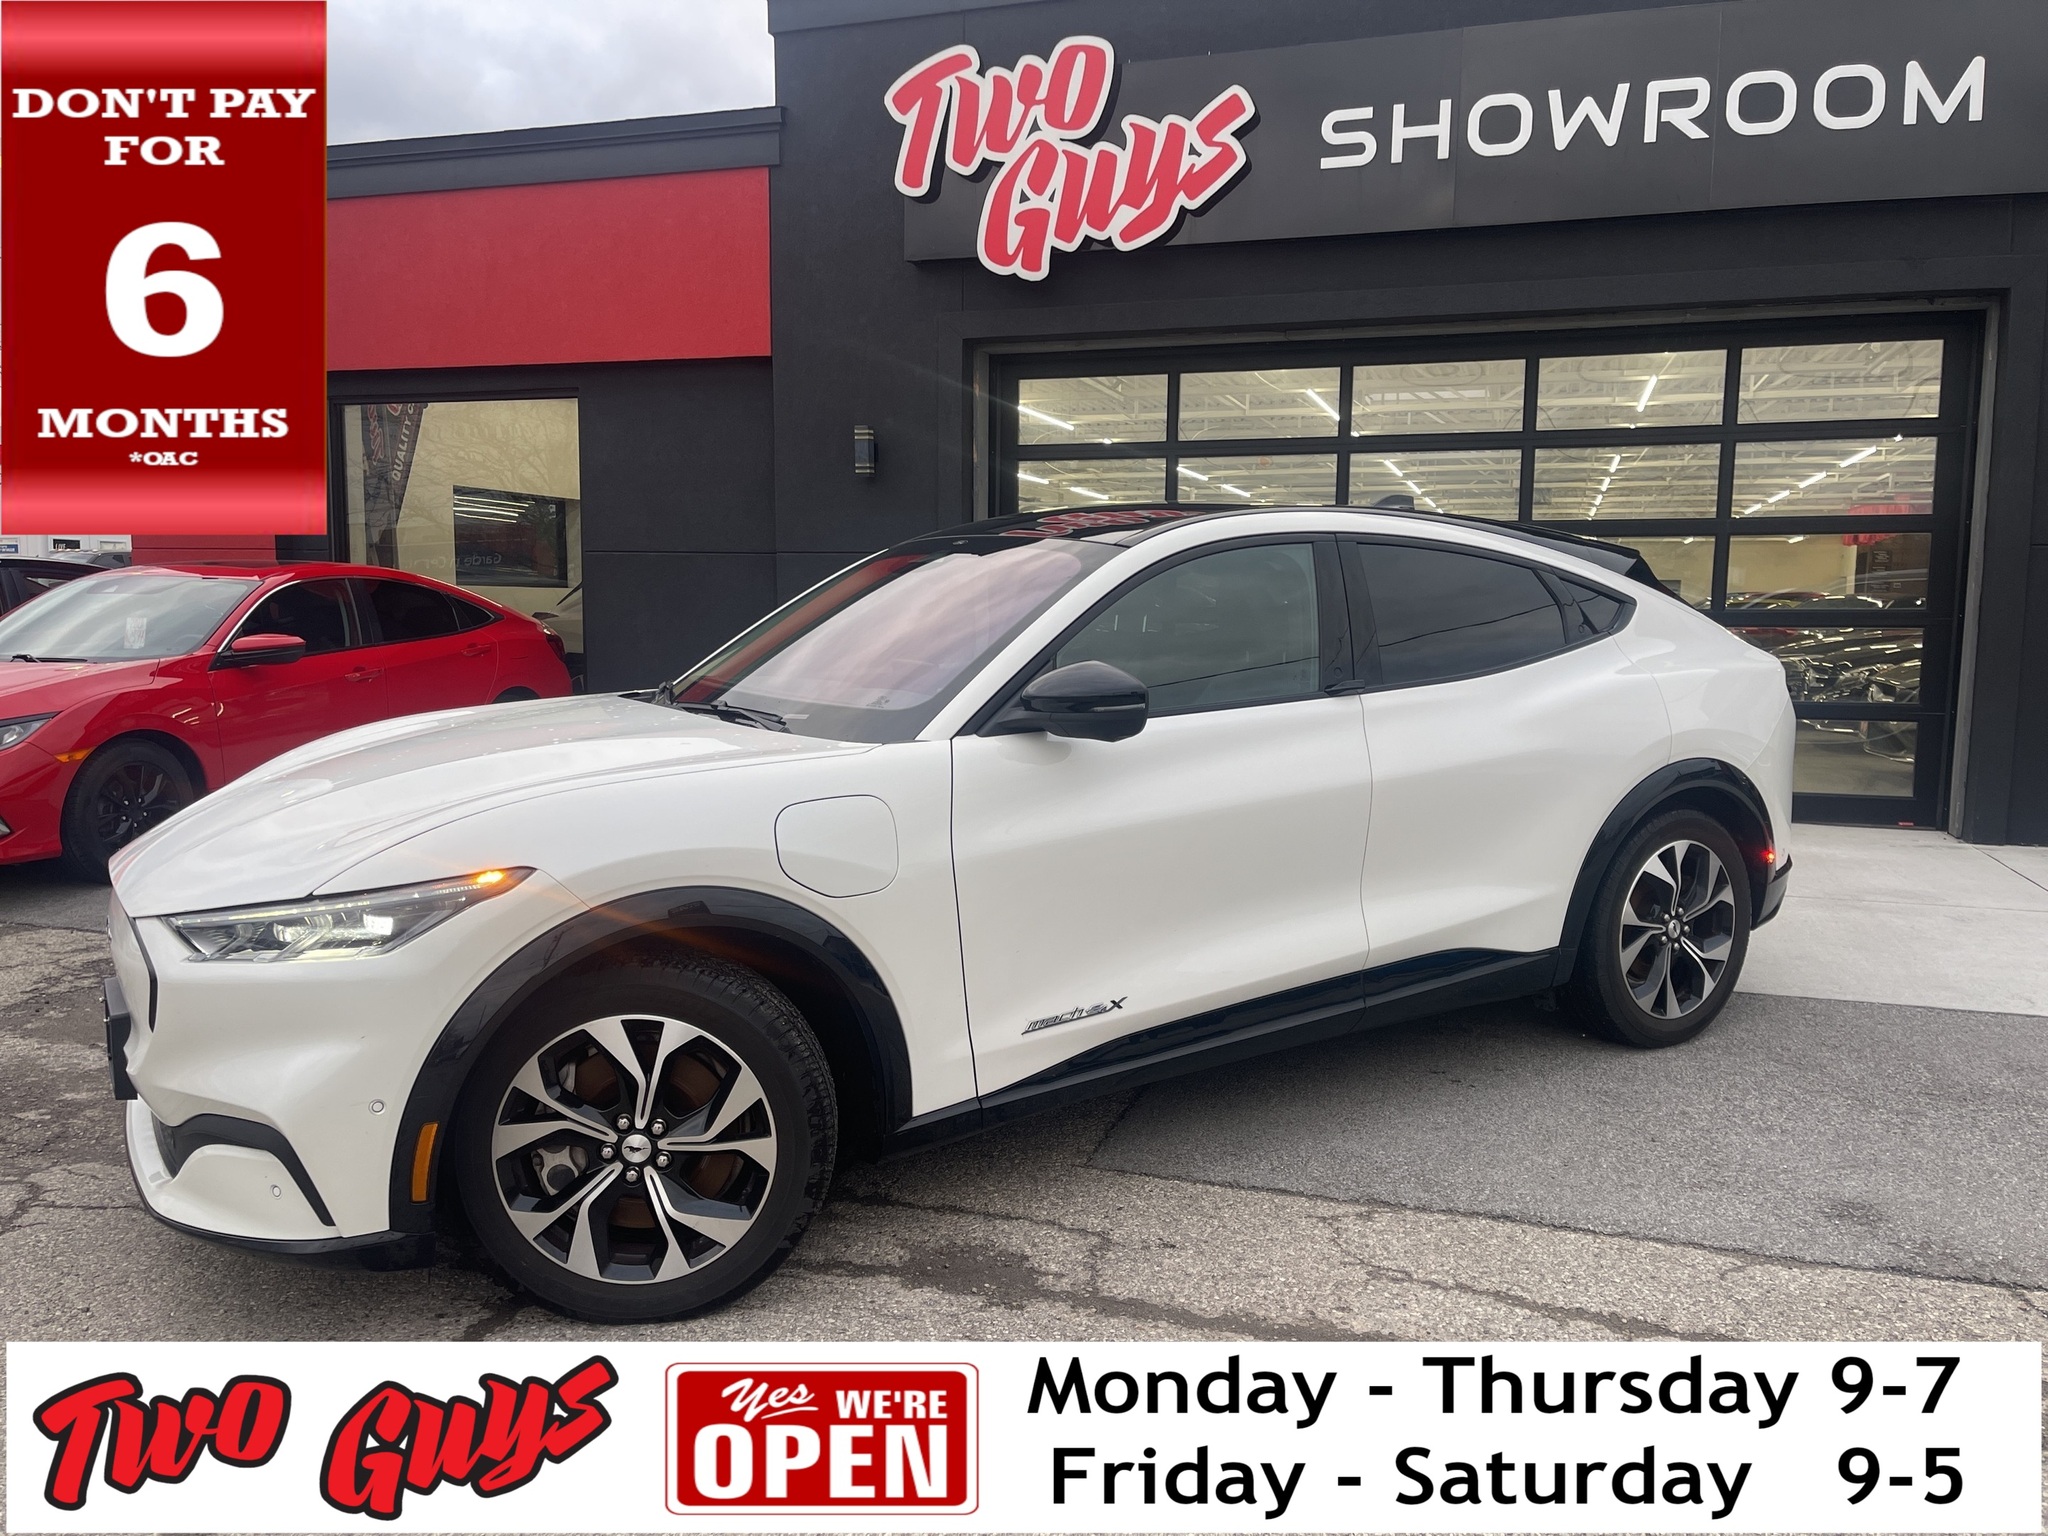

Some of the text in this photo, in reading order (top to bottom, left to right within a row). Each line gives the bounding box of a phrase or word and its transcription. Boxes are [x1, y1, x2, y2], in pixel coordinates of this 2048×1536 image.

[885, 36, 1114, 197] Two
[1321, 56, 1985, 169] SHOWROOM
[977, 85, 1256, 281] Guys
[392, 416, 411, 481] QUALITY
